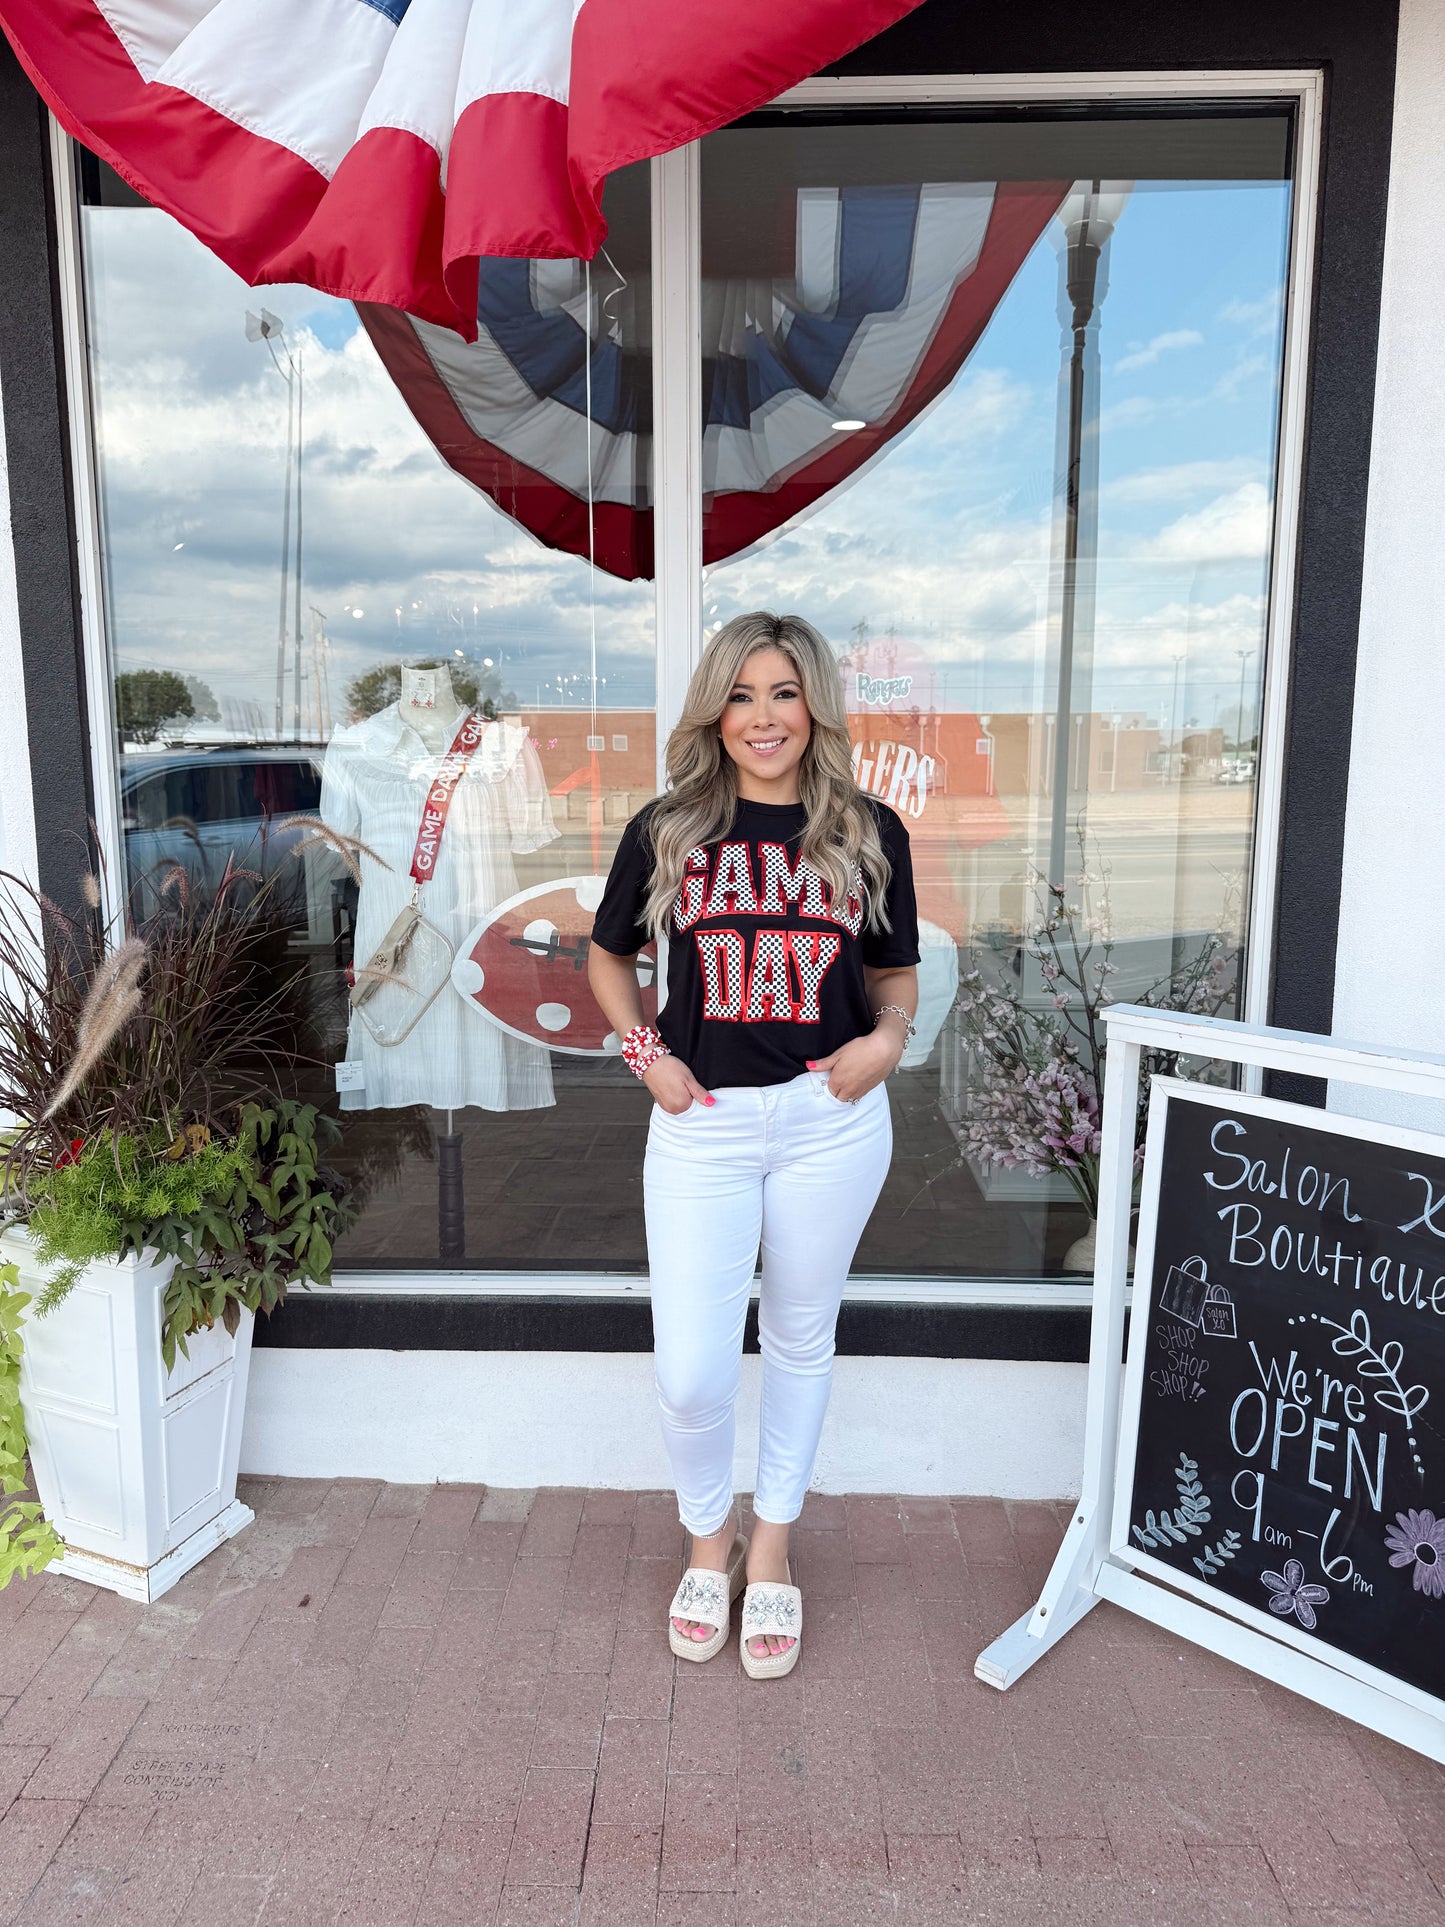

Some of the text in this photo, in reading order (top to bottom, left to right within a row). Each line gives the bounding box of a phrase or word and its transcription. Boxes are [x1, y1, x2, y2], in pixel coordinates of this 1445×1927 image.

[857, 672, 912, 704] Rangers
[416, 809, 443, 871] GAME
[695, 929, 841, 1024] DAY
[1202, 1119, 1362, 1223] Salon
[1216, 1203, 1445, 1315] Boutique
[1155, 1325, 1196, 1350] SHOP
[1205, 1307, 1230, 1321] Salon
[1150, 1369, 1207, 1402] SHOP!!
[1167, 1350, 1210, 1379] SHOP
[1248, 1341, 1367, 1422] We're
[1229, 1388, 1388, 1512] OPEN
